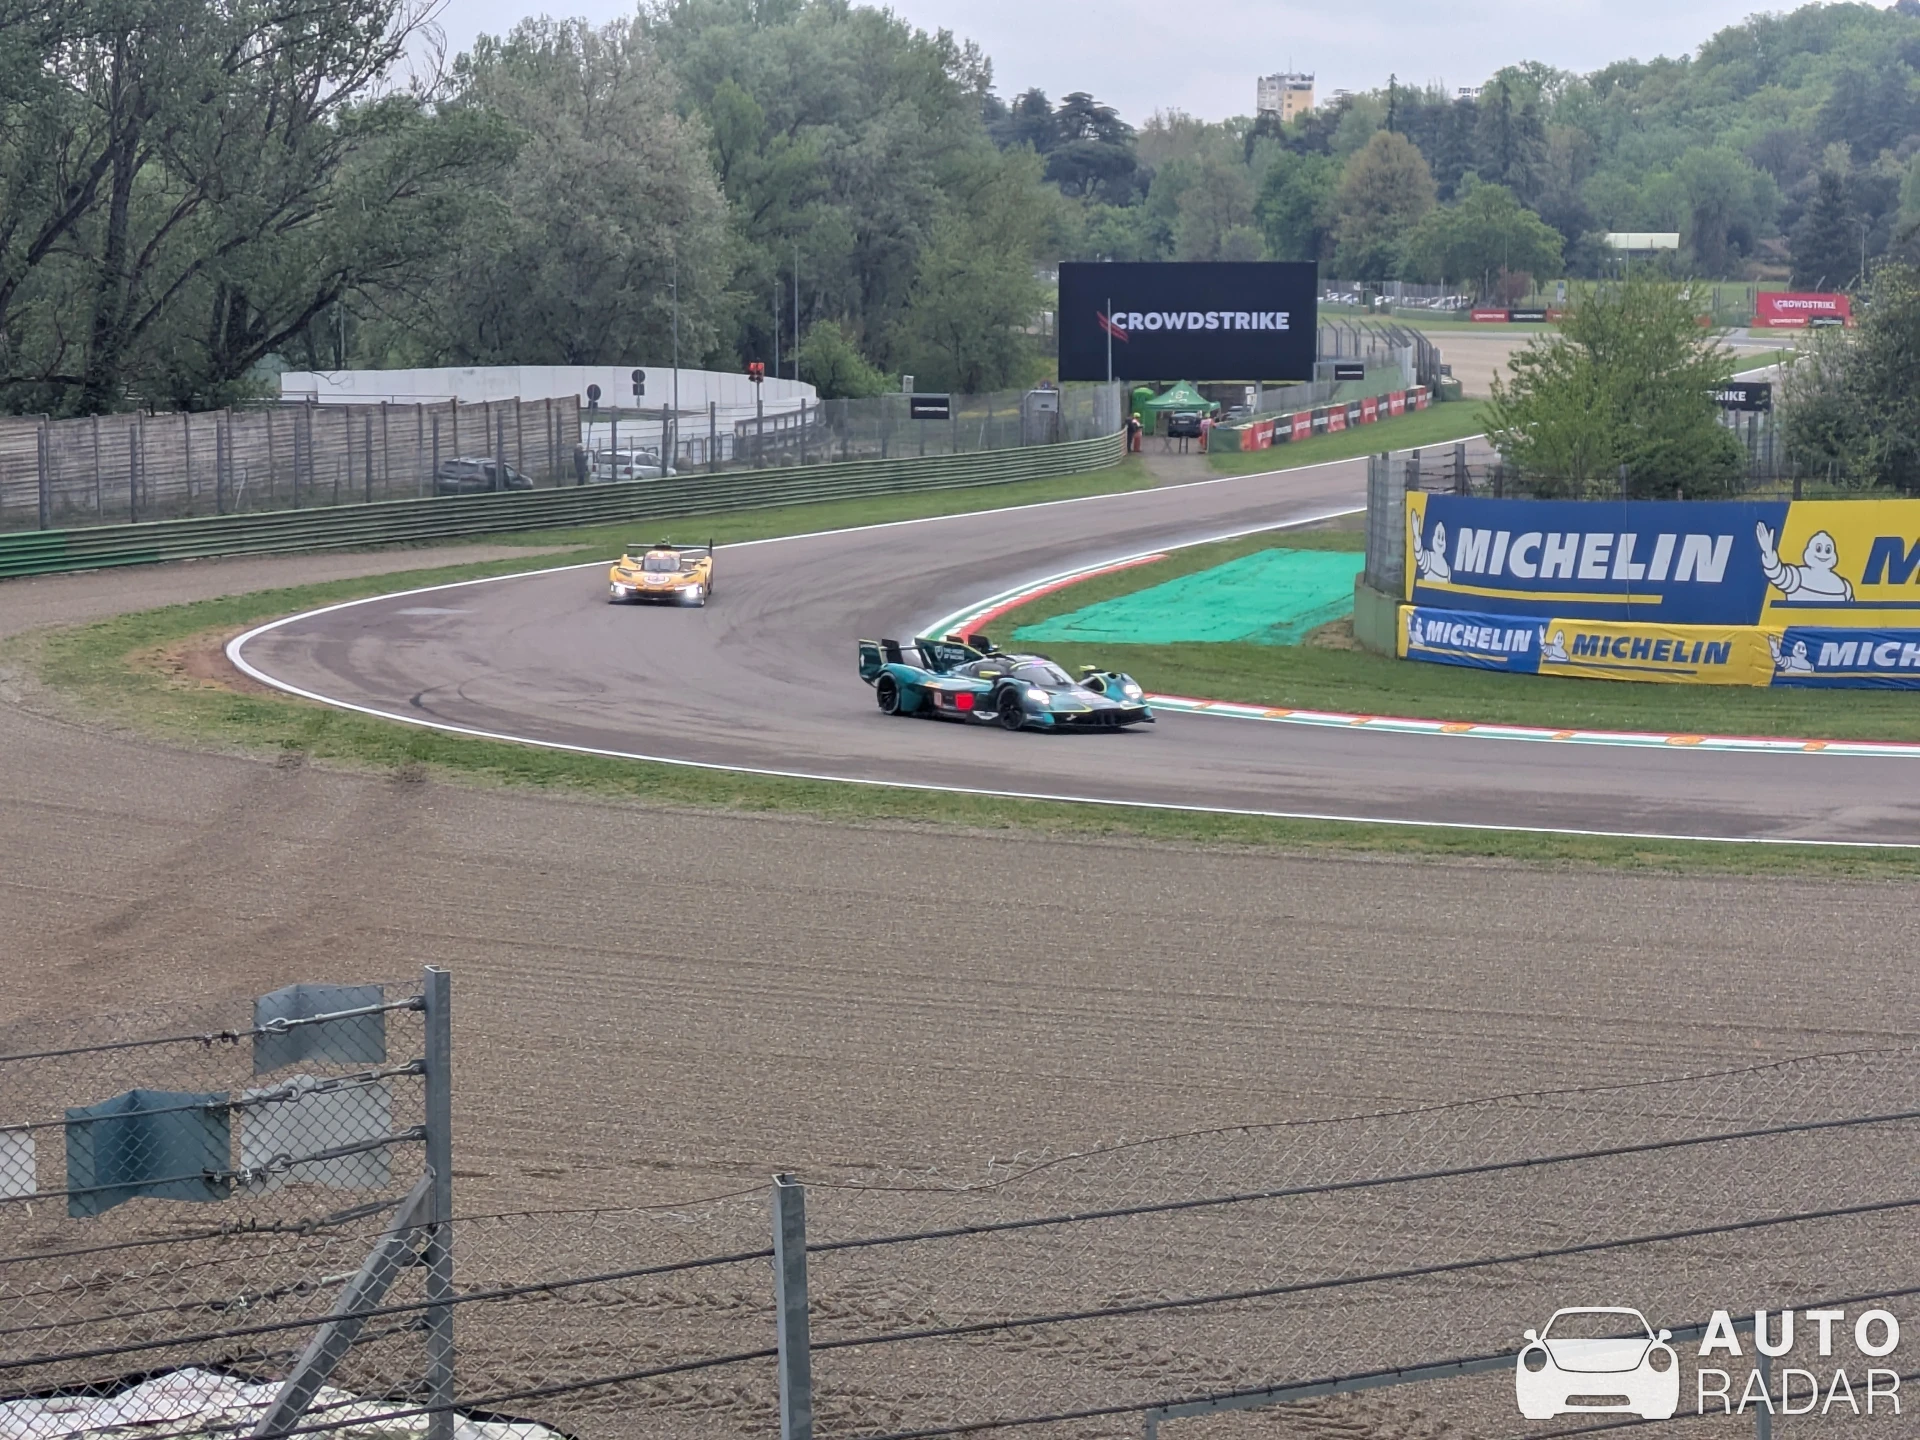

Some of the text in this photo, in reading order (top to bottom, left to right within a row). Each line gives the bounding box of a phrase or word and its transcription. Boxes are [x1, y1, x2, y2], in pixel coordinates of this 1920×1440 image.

[1111, 311, 1290, 330] CROWDSTRIKE
[1454, 527, 1734, 583] MICHELIN
[1426, 620, 1533, 652] MICHELIN
[1571, 633, 1732, 665] MICHELIN
